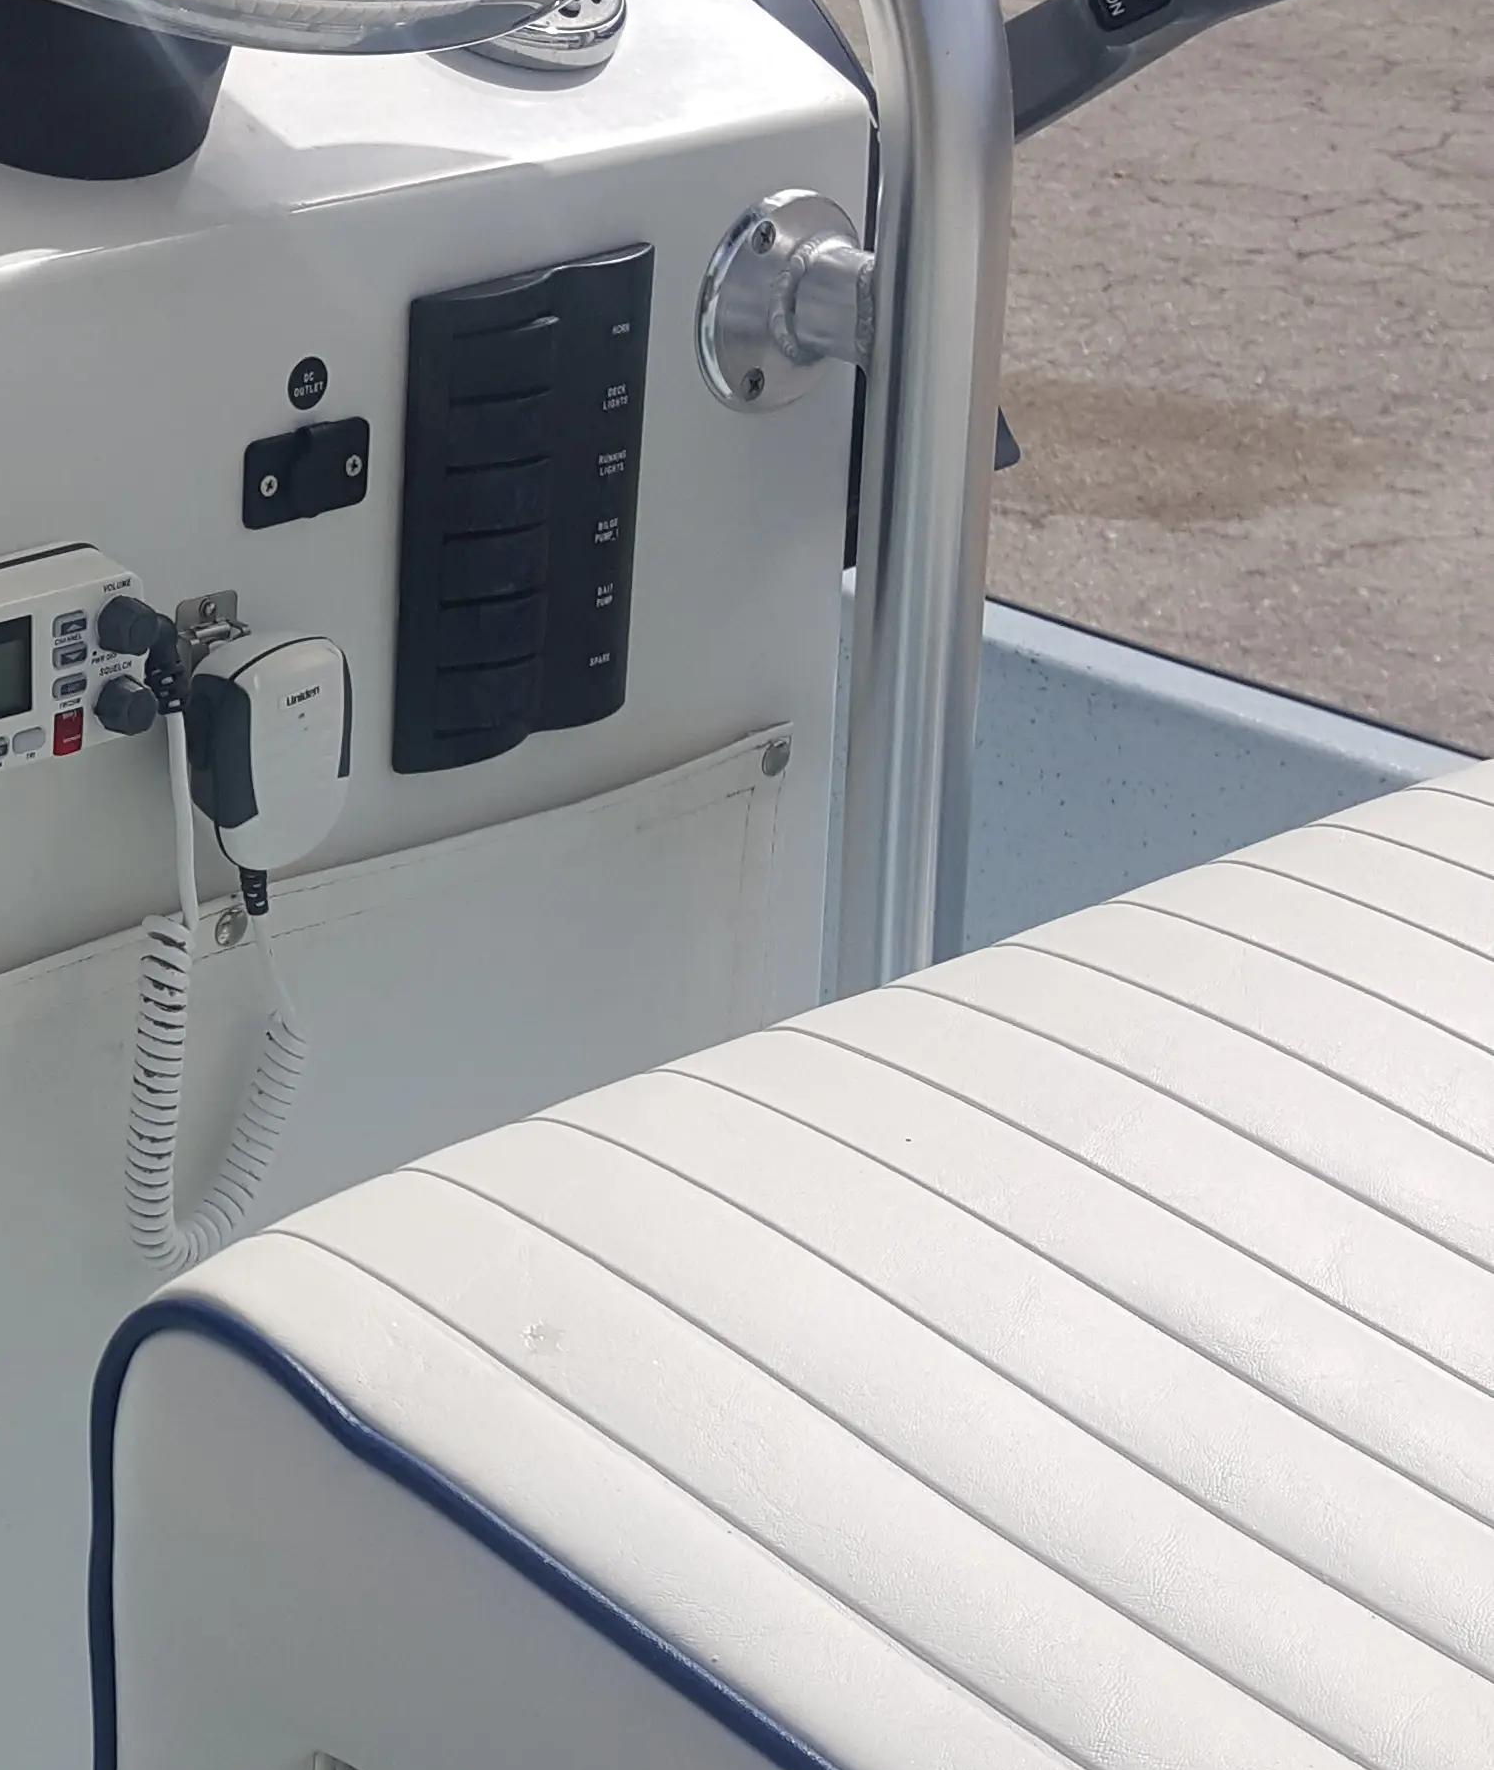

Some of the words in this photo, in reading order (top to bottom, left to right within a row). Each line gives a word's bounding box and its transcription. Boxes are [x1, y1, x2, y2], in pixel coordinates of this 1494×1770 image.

[303, 371, 315, 383] DC
[293, 381, 324, 397] OUTLET
[607, 383, 627, 398] DECK
[602, 395, 629, 411] LIGHTS
[598, 449, 627, 466] RUNNING
[599, 462, 625, 477] LIGHTS
[103, 578, 132, 593] VOLUME
[595, 595, 613, 608] PUMP
[54, 633, 82, 646] CHANNEL
[589, 653, 611, 667] SPARE
[99, 660, 132, 676] SQUELCH
[286, 685, 321, 707] Uniden
